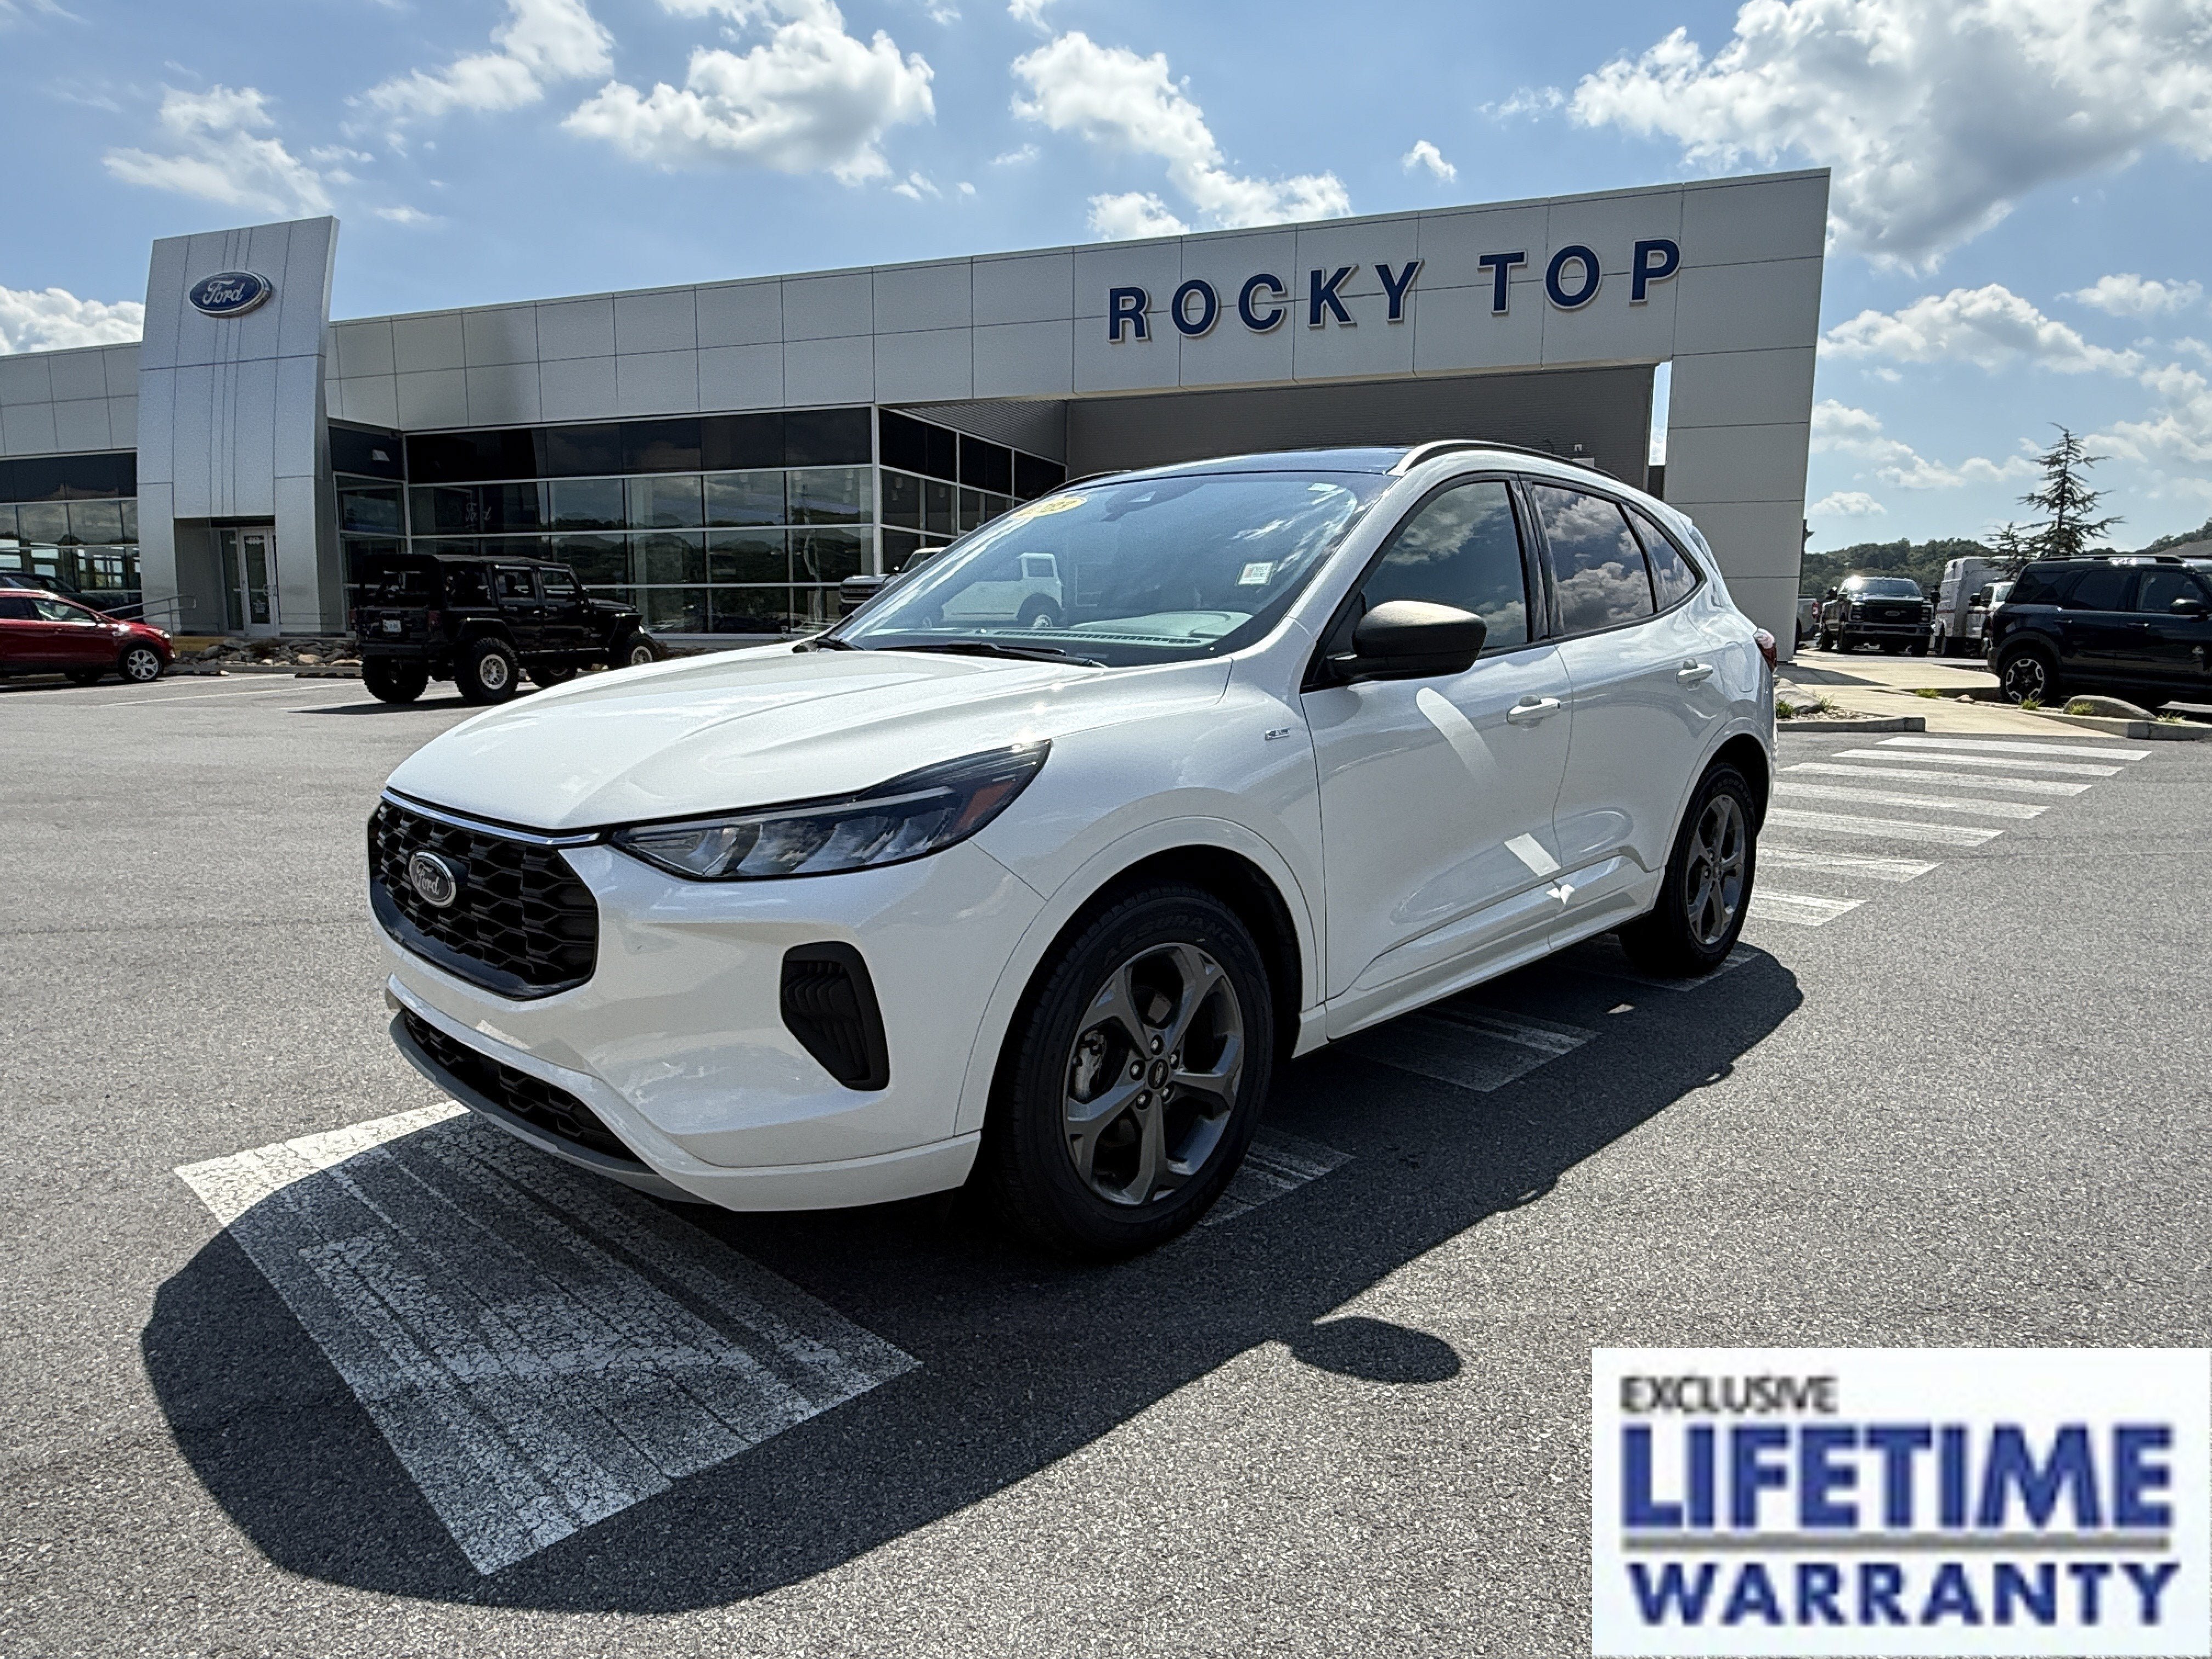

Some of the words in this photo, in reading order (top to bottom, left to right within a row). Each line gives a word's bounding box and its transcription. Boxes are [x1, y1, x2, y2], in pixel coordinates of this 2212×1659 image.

[202, 280, 246, 305] Ford
[1107, 258, 1425, 343] ROCKY
[1477, 237, 1683, 316] TOP
[414, 860, 440, 895] Ford
